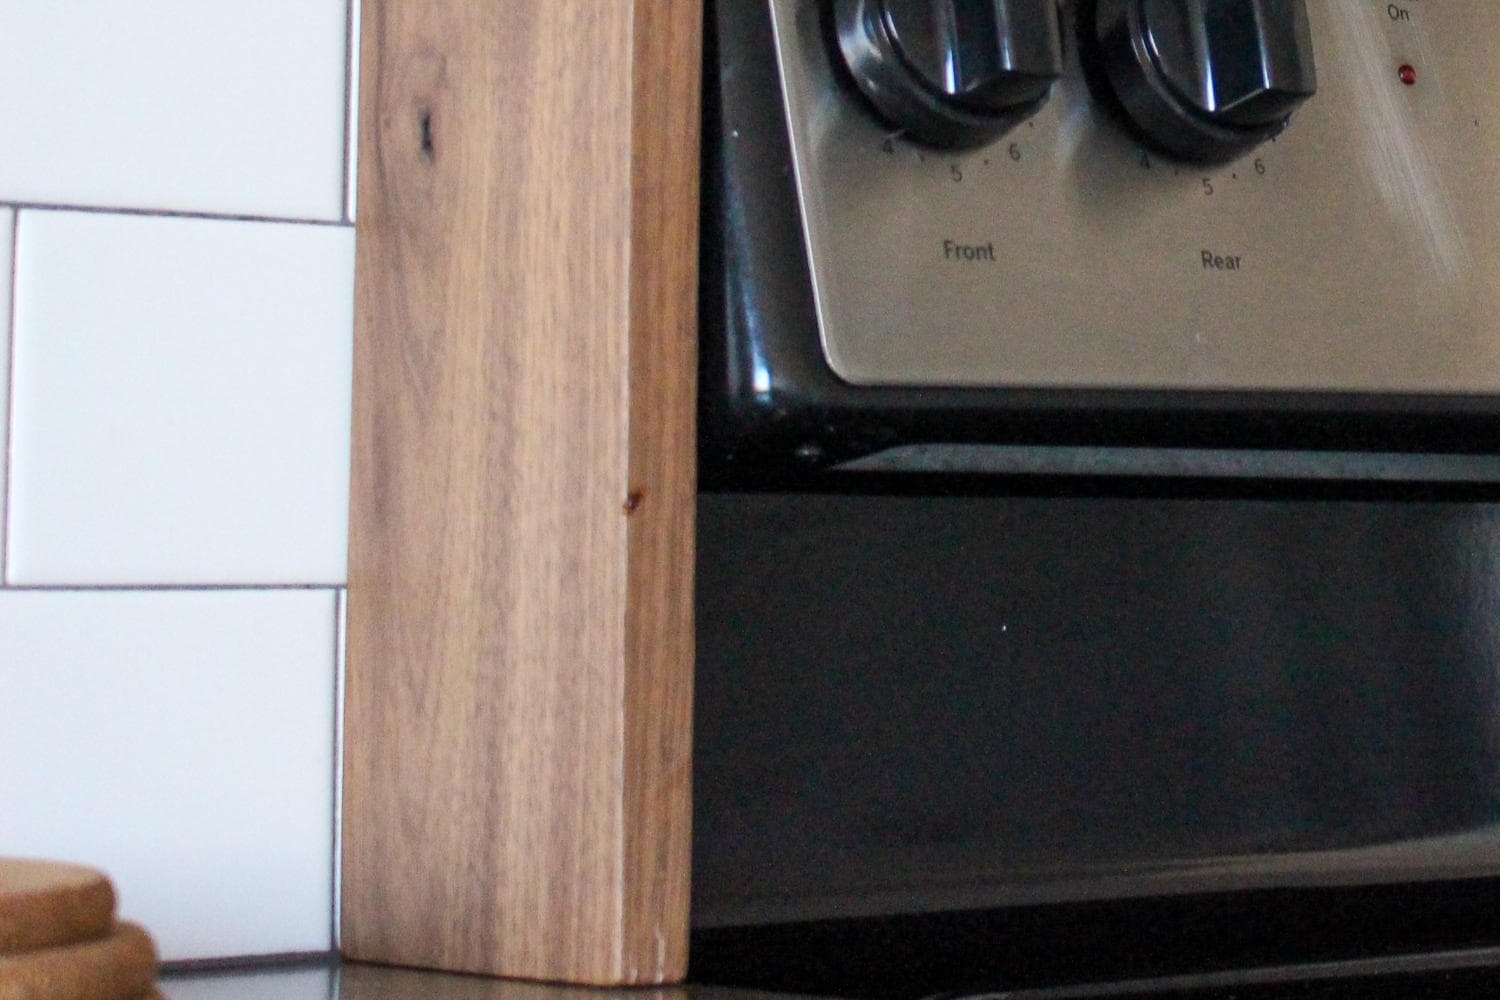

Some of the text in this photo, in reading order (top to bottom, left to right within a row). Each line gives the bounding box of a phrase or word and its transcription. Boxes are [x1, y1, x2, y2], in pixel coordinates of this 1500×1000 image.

[1387, 3, 1410, 21] On
[1009, 143, 1022, 162] 6
[951, 165, 963, 183] 5
[1254, 157, 1266, 175] 6
[1202, 178, 1214, 196] 5
[943, 239, 997, 262] Front
[1201, 250, 1242, 271] Rear
